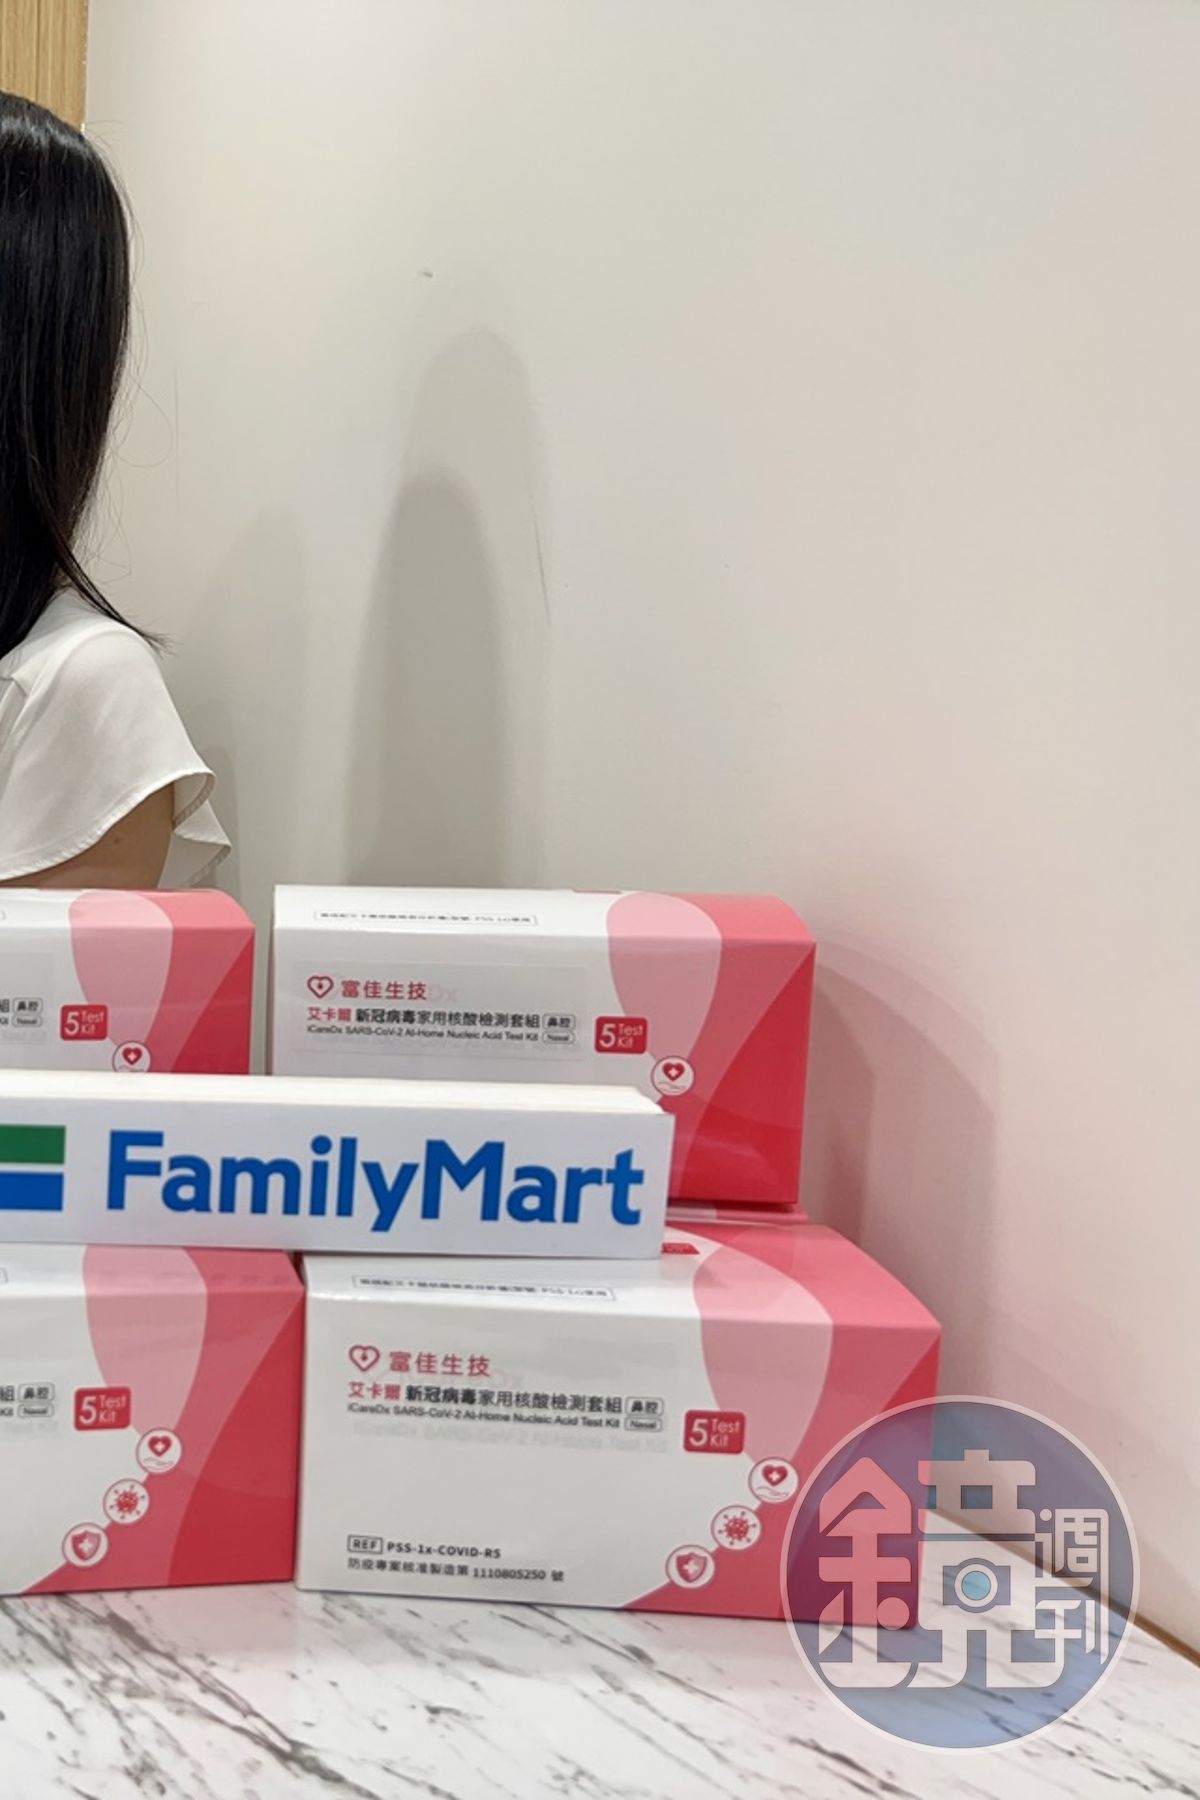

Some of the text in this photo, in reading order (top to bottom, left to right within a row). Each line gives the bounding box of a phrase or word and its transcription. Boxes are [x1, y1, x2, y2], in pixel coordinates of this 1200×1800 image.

[341, 980, 427, 1000] 富佳生技
[64, 1010, 104, 1036] 5 Test
[599, 1023, 643, 1048] 5 Test
[107, 1129, 644, 1232] FamilyMart
[389, 1351, 491, 1378] 富佳生技
[0, 1407, 14, 1417] Kit
[79, 1394, 126, 1425] 5 Test
[555, 1415, 578, 1426] Acid
[581, 1416, 603, 1427] Test
[606, 1418, 620, 1428] Kit
[689, 1418, 708, 1447] 5
[711, 1418, 740, 1433] Test
[353, 1539, 377, 1550] REF
[473, 1567, 546, 1580] 1110805250
